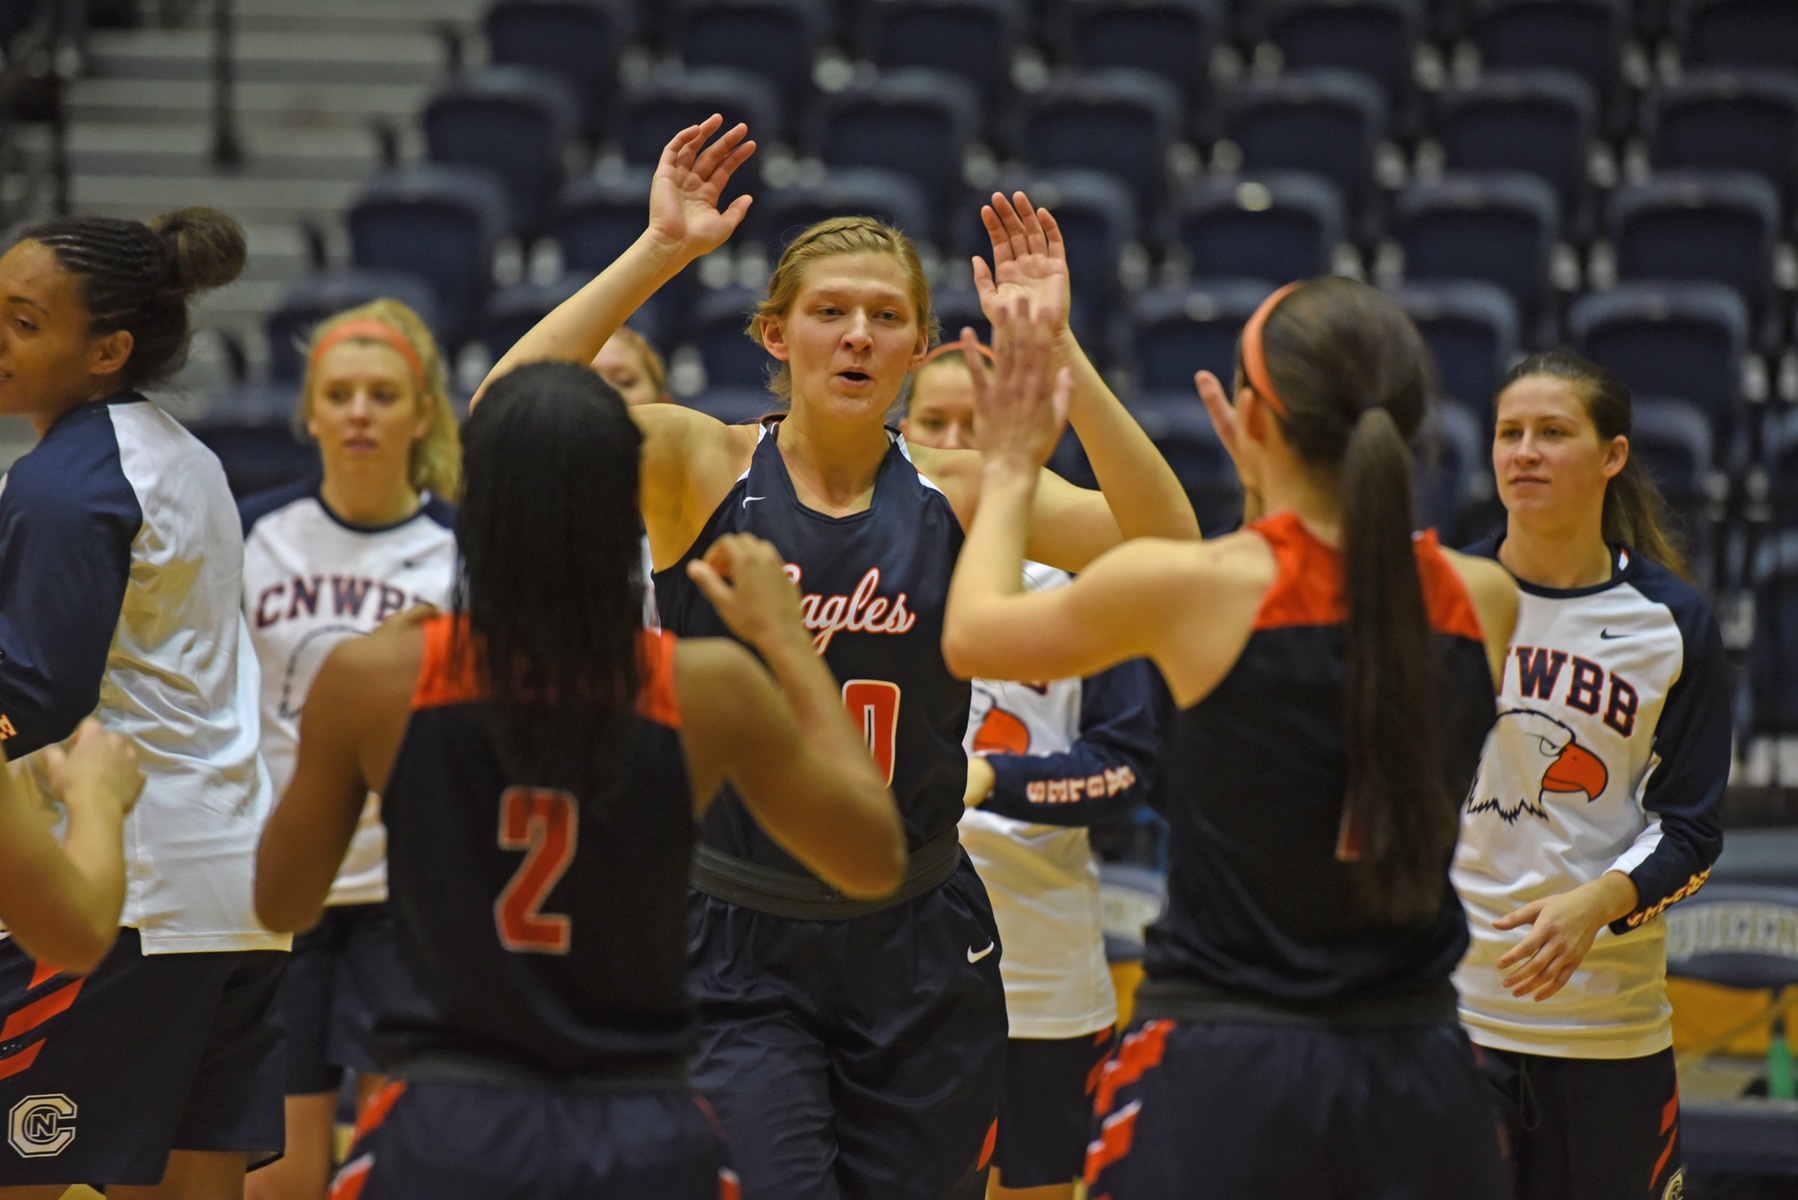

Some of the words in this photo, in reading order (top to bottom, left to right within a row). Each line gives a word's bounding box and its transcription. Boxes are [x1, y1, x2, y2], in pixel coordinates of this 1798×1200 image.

[256, 573, 436, 631] CNWB
[783, 563, 916, 656] agles
[1501, 646, 1639, 739] WBB
[494, 785, 579, 955] 2
